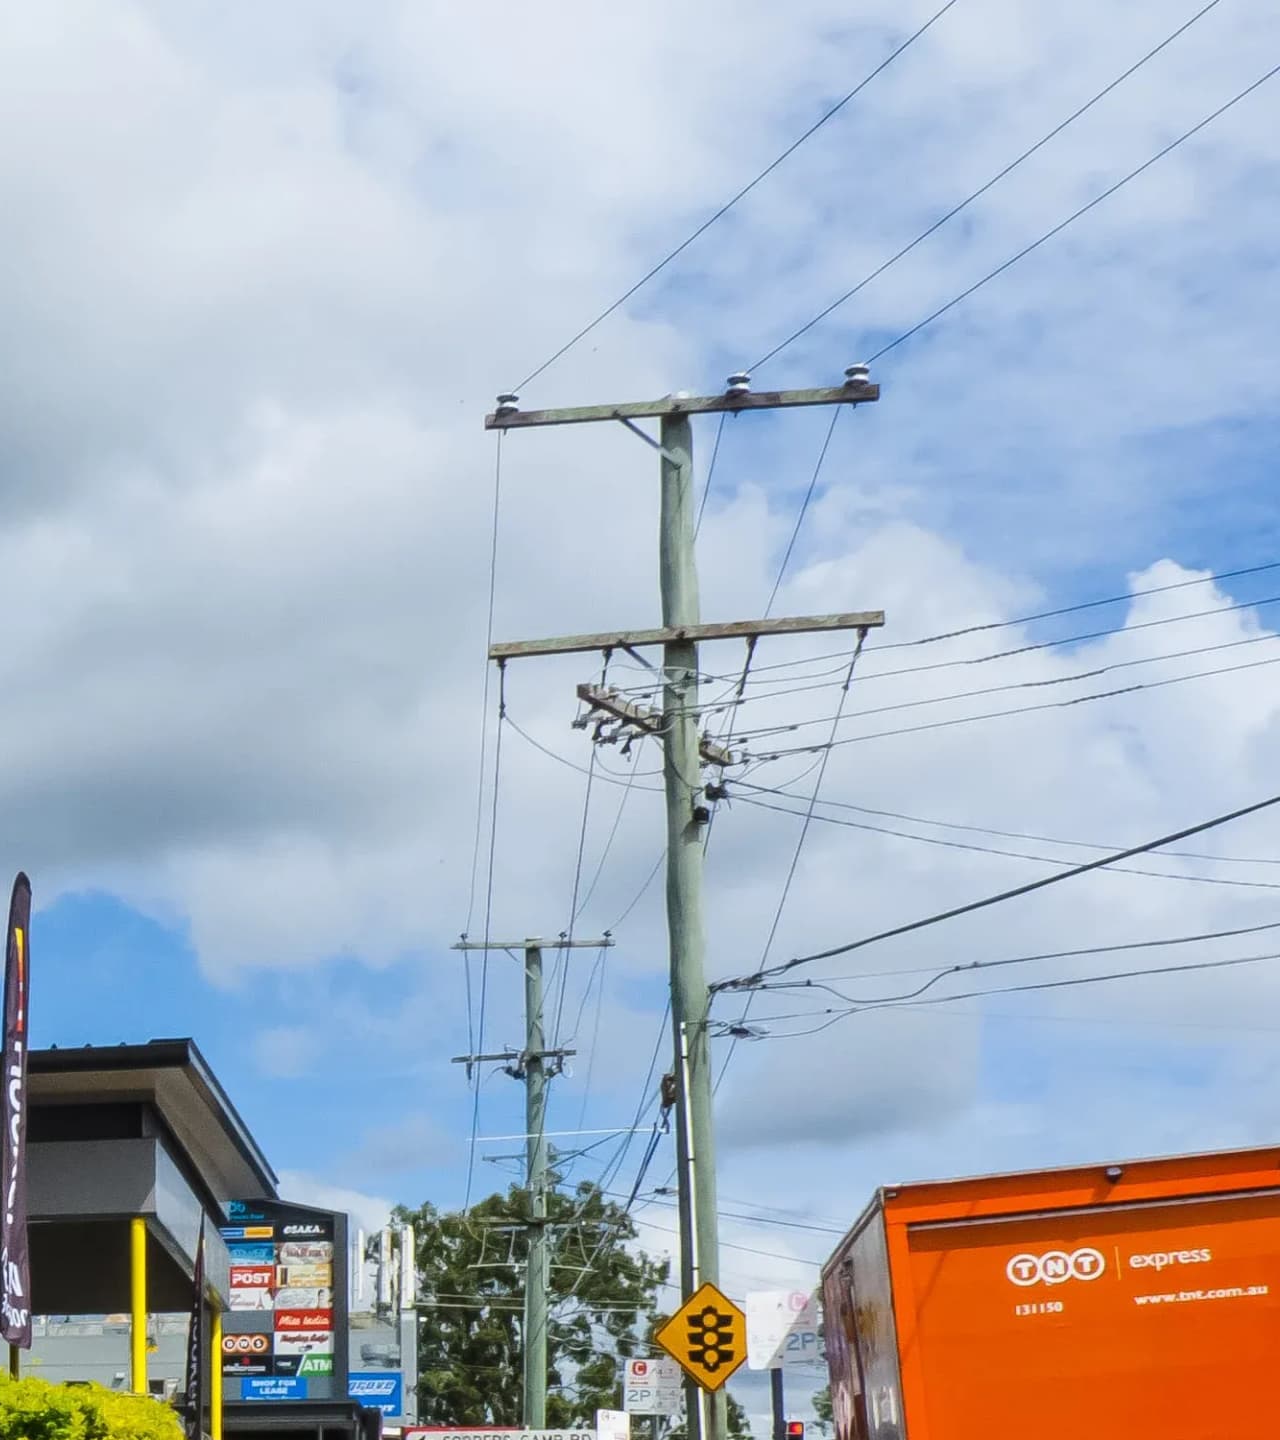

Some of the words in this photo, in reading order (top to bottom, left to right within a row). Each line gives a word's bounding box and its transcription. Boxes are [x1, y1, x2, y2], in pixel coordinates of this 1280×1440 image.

[1010, 1251, 1101, 1283] TNT
[1129, 1248, 1211, 1271] express
[232, 1273, 271, 1284] POST
[1134, 1284, 1269, 1306] www.tnt.com.au
[786, 1332, 817, 1351] 2P
[303, 1359, 333, 1371] ATM
[627, 1389, 652, 1402] 2P
